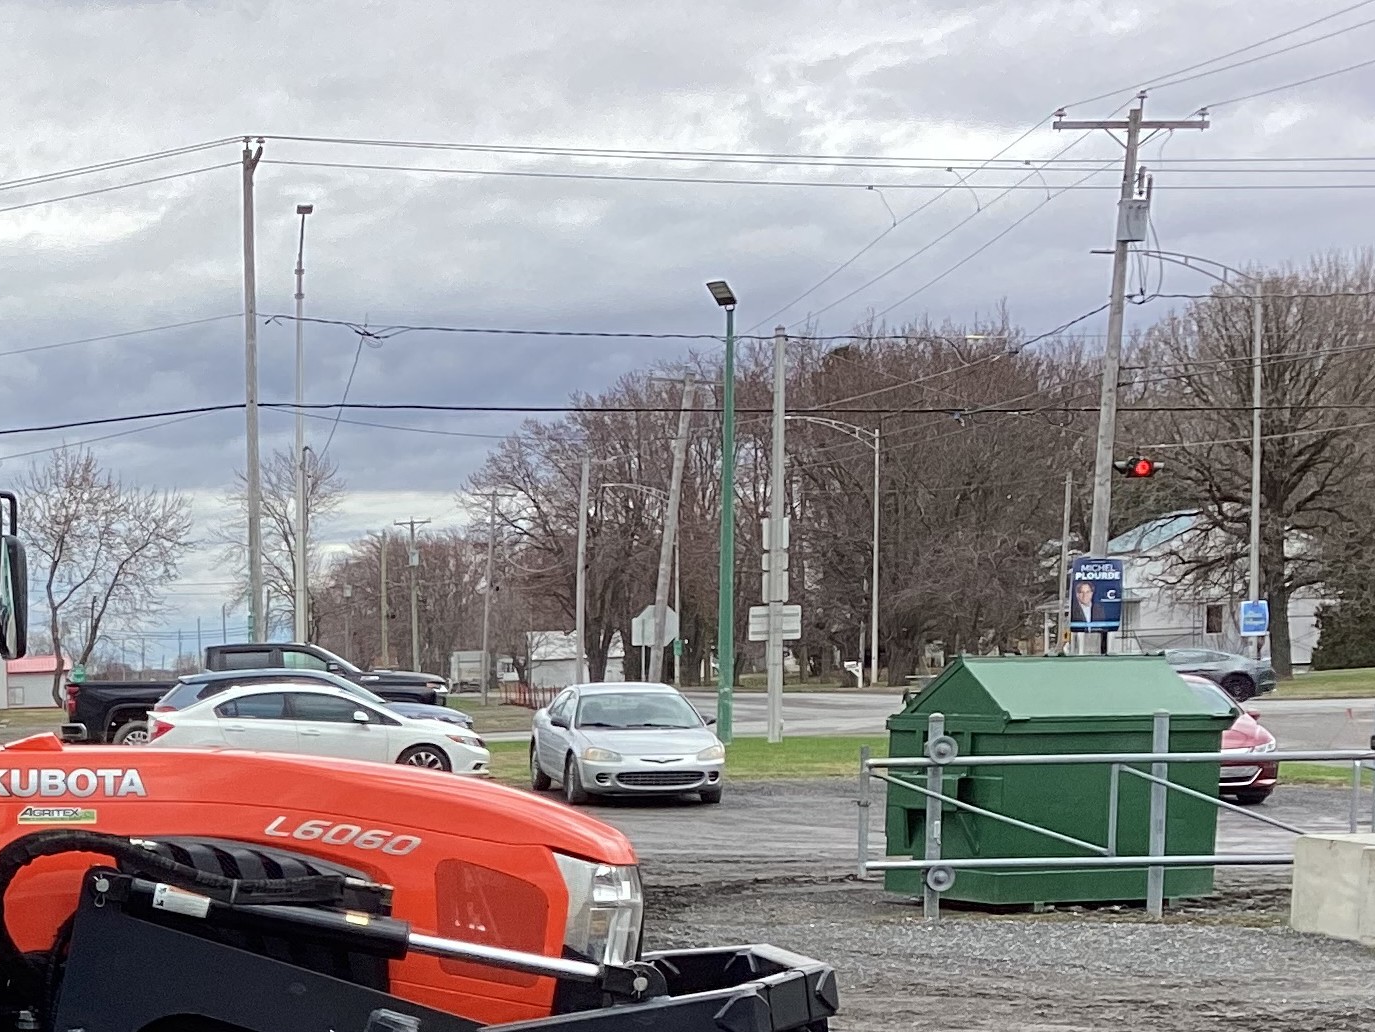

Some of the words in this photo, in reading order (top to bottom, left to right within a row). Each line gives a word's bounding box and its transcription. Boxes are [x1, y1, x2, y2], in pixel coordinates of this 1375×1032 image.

[1080, 564, 1116, 572] MICHEL
[1075, 571, 1121, 581] PLOURDE
[20, 807, 81, 818] AGRITEX
[263, 815, 423, 857] L6060
